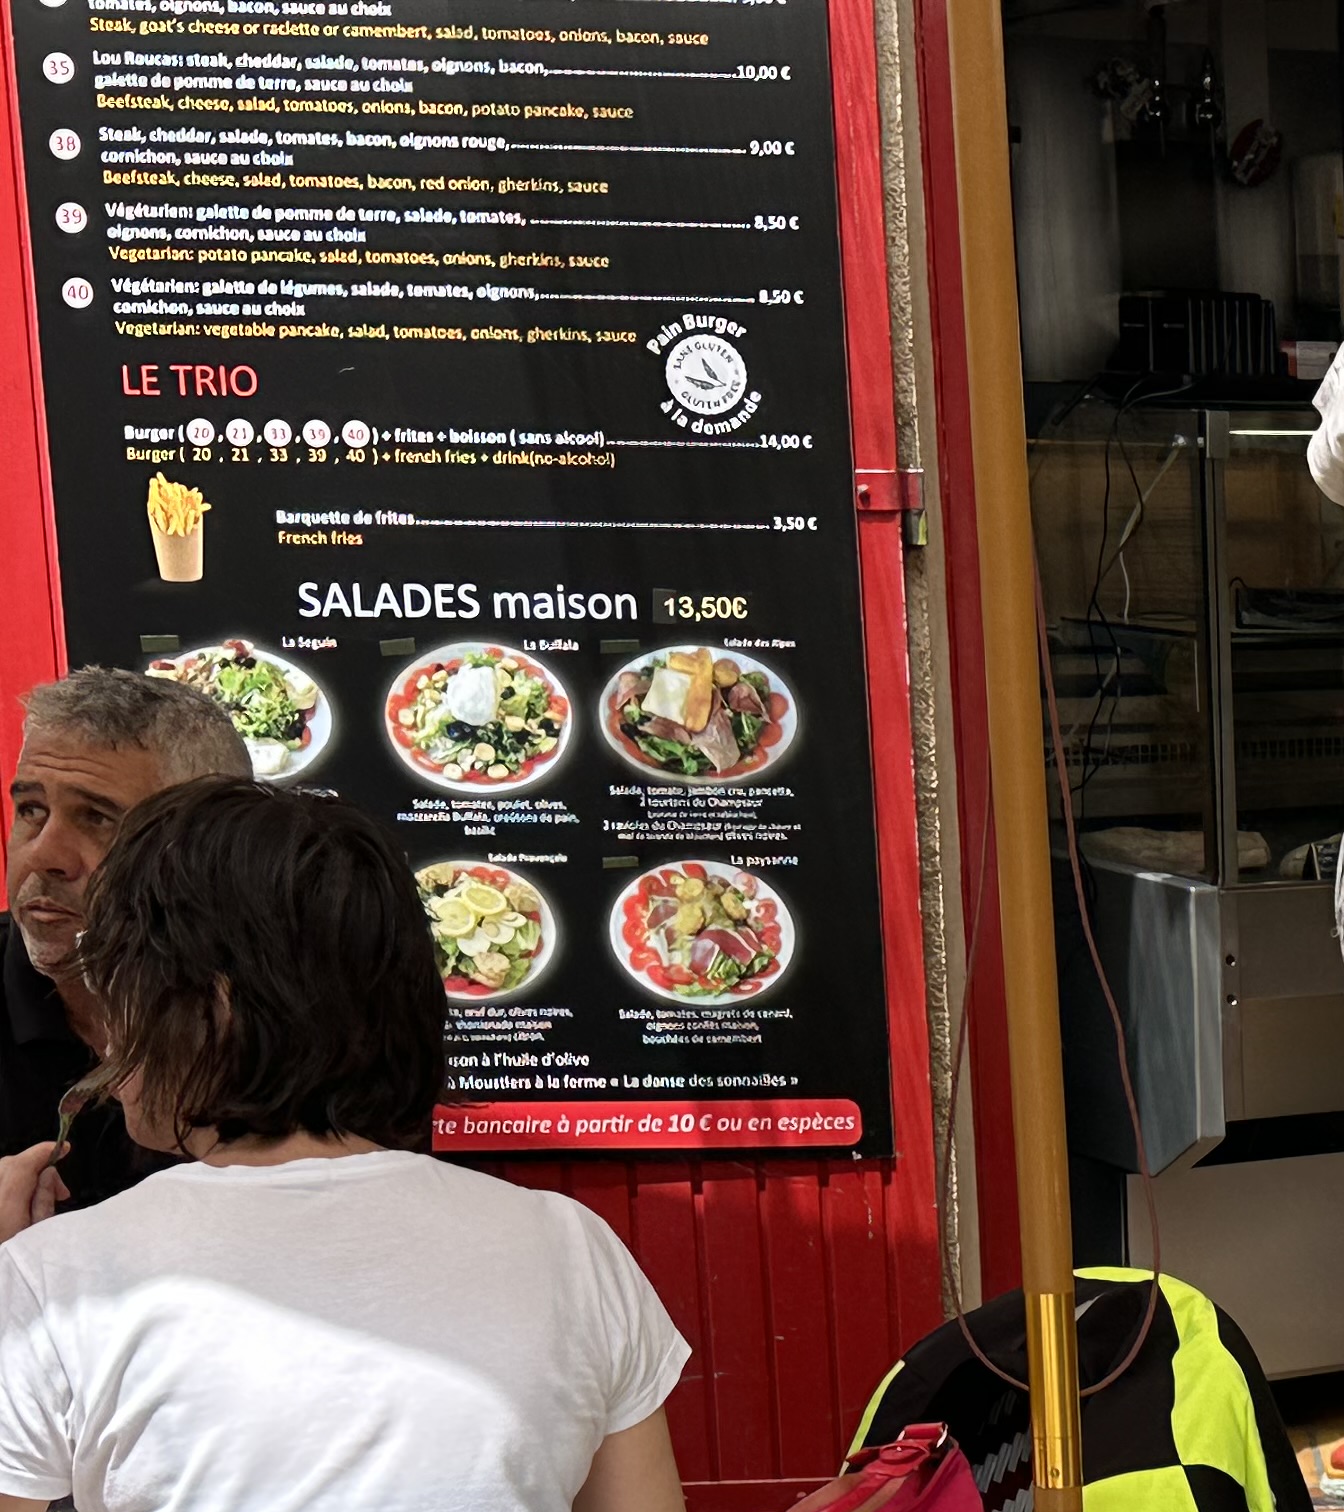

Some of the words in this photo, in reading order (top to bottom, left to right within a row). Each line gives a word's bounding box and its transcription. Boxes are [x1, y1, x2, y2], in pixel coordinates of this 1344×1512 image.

[90, 18, 136, 34] Steak,
[139, 19, 185, 35] goat's
[188, 20, 240, 35] cheese
[243, 23, 261, 34] or
[323, 25, 340, 36] or
[482, 27, 556, 43] tomatoes,
[559, 28, 612, 44] onions,
[616, 29, 664, 45] bacon,
[49, 62, 69, 75] 35
[93, 50, 121, 65] Lou
[124, 51, 183, 67] Roucas:
[186, 53, 233, 70] steak,
[235, 53, 302, 71] cheddar,
[305, 55, 359, 72] salade,
[361, 57, 429, 74] tomates,
[431, 57, 495, 75] oignons,
[499, 59, 549, 77] bacon,
[736, 65, 777, 81] 10,00
[97, 94, 174, 111] Beefsteak,
[177, 95, 234, 112] cheese,
[237, 96, 280, 113] salad,
[283, 99, 359, 115] tomatoes,
[362, 99, 416, 116] onions,
[419, 100, 468, 116] bacon,
[472, 103, 520, 118] potato
[524, 103, 589, 119] pancake,
[593, 107, 633, 118] sauce
[57, 138, 76, 151] 38
[99, 127, 146, 144] Steak,
[149, 128, 216, 145] cheddar,
[219, 130, 273, 146] salade,
[275, 131, 343, 147] tomates,
[346, 132, 397, 149] bacon,
[399, 133, 459, 150] oignons
[462, 137, 509, 151] rouge,
[750, 140, 782, 156] 9,00
[60, 211, 81, 224] 39
[67, 287, 88, 300] 40
[682, 313, 747, 338] Burger
[646, 322, 682, 355] Pain
[122, 365, 160, 395] LE
[169, 365, 257, 396] TRIO
[671, 408, 688, 428] la
[691, 391, 762, 435] demande
[124, 425, 174, 443] Burger
[194, 428, 209, 438] 20
[233, 428, 246, 439] 21
[348, 430, 364, 440] 40
[394, 429, 434, 445] frites
[449, 429, 507, 444] boisson
[519, 433, 552, 444] sans
[759, 434, 800, 450] 14,00
[802, 435, 812, 448] €
[127, 447, 176, 463] Burger
[193, 448, 211, 461] 20
[232, 446, 249, 461] 21
[270, 446, 288, 462] 33
[309, 447, 326, 462] 39
[346, 447, 365, 462] 40
[395, 448, 441, 463] french
[445, 449, 476, 464] fries
[276, 510, 350, 527] Barquette
[353, 510, 372, 525] de
[375, 510, 414, 525] frites
[773, 517, 805, 532] 3,50
[807, 517, 817, 530] €
[278, 531, 327, 544] French
[331, 530, 363, 545] fries
[299, 582, 480, 618] SALADES
[494, 584, 637, 619] maison
[664, 596, 747, 621] 13,50€
[459, 1075, 531, 1089] Moustiers
[535, 1075, 543, 1088] à
[547, 1075, 560, 1088] la
[563, 1075, 606, 1088] ferme
[623, 1075, 639, 1088] La
[643, 1074, 685, 1088] danse
[689, 1074, 713, 1087] des
[464, 1115, 552, 1134] bancaire
[557, 1114, 569, 1133] à
[575, 1114, 633, 1136] partir
[638, 1115, 660, 1132] de
[668, 1115, 694, 1132] 10
[700, 1116, 711, 1131] €
[717, 1118, 741, 1131] ou
[747, 1118, 771, 1130] en
[777, 1114, 855, 1137] espèces
